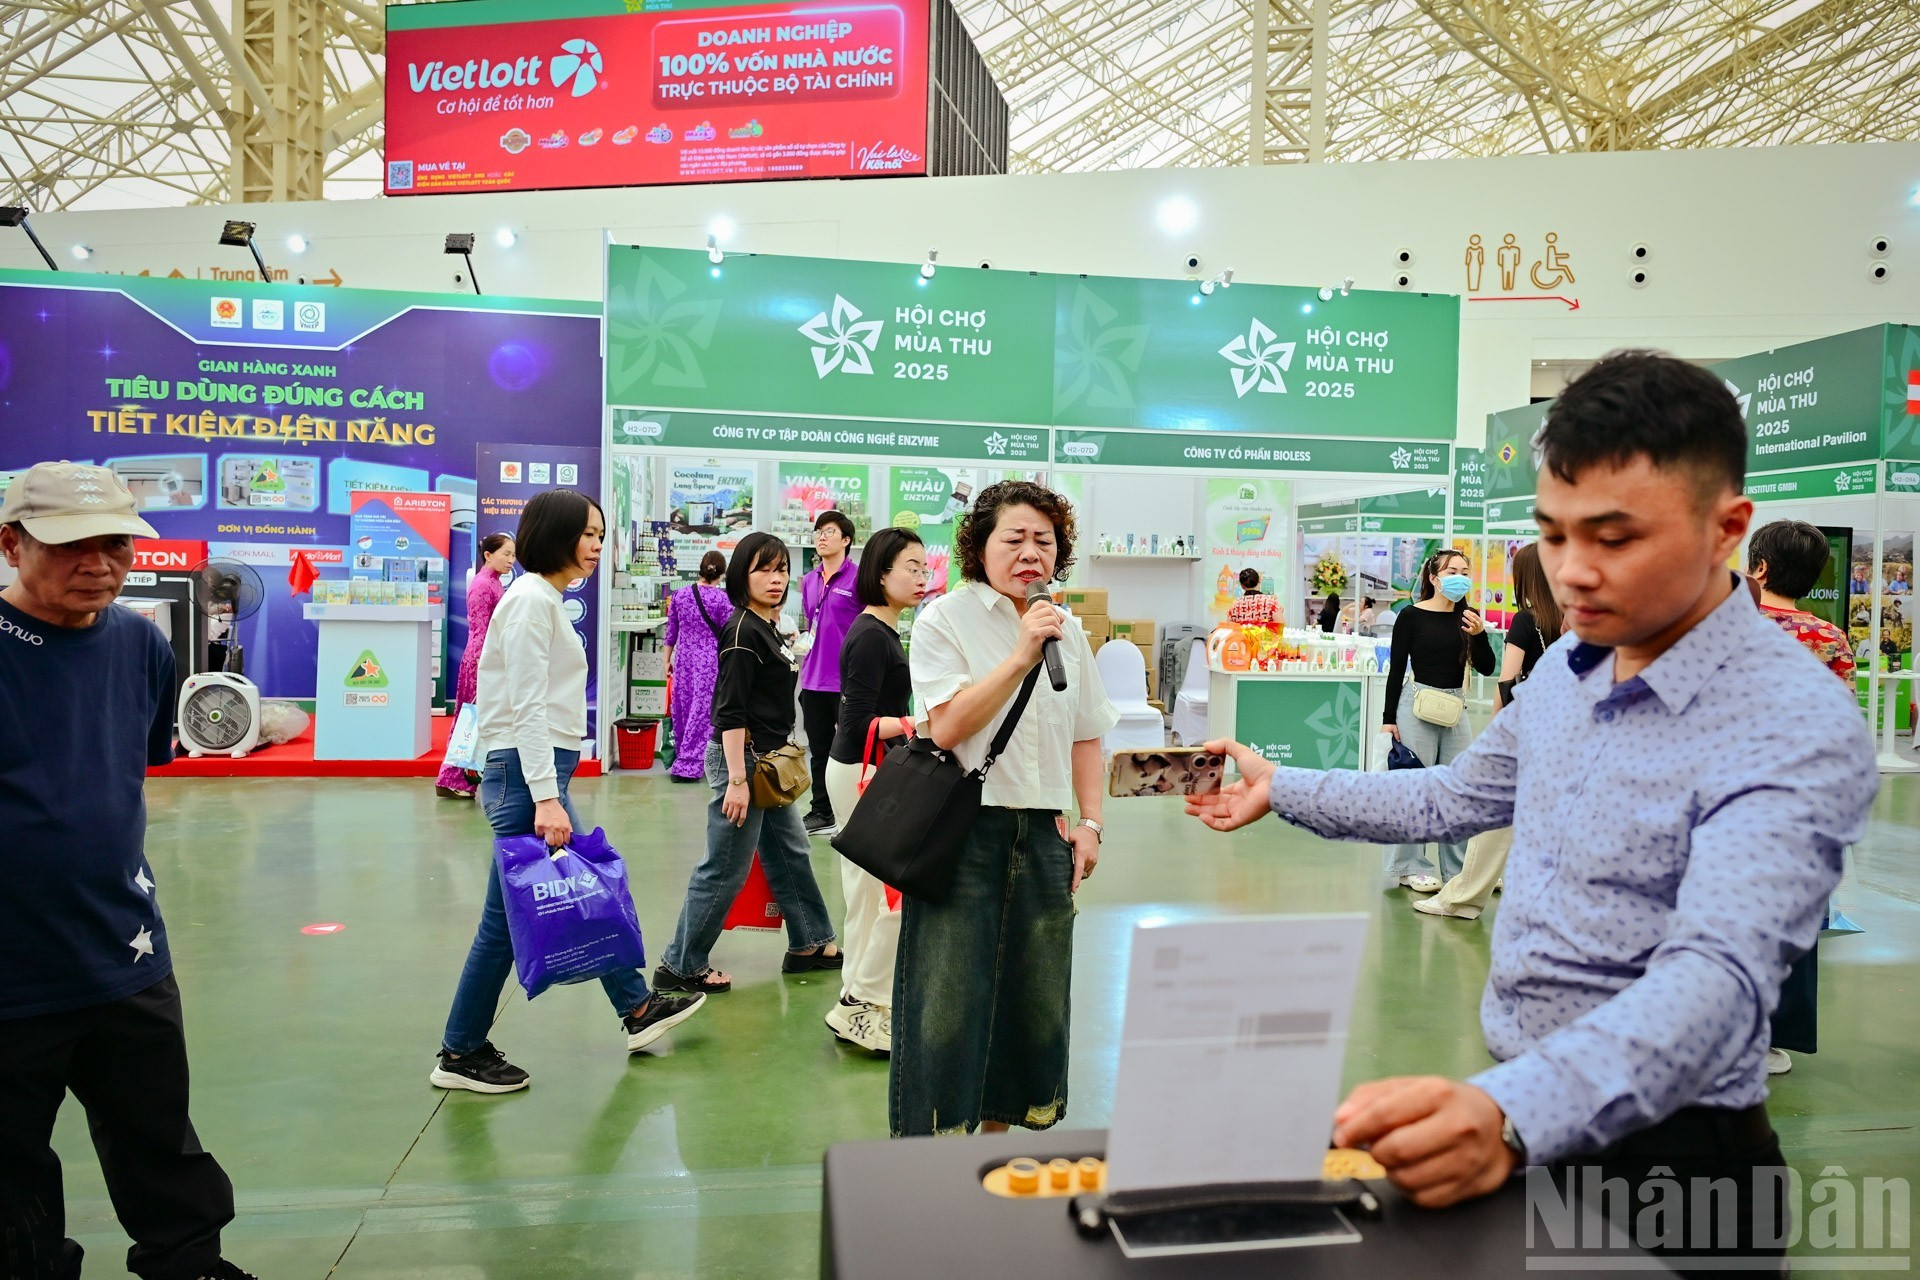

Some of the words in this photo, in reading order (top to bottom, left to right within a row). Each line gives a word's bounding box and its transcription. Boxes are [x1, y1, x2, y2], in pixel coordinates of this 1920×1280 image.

[698, 27, 771, 48] DOANH
[776, 20, 852, 44] NGHIỆP
[659, 52, 729, 77] 100%
[734, 50, 778, 72] VỐN
[783, 48, 828, 70] NHÀ
[832, 45, 893, 67] NƯỚC
[408, 56, 541, 92] Vietlott
[659, 80, 705, 100] TRỰC
[710, 76, 769, 97] THUỘC
[773, 74, 799, 95] BỘ
[803, 74, 831, 90] TÀI
[835, 70, 893, 88] CHÍNH
[437, 99, 455, 114] Cơ
[458, 98, 479, 115] hội
[483, 95, 499, 112] để
[503, 94, 522, 110] tốt
[526, 95, 554, 109] hơn
[417, 162, 437, 172] MUA
[439, 161, 450, 171] VÉ
[452, 161, 466, 172] TẠI
[210, 267, 255, 285] Trung
[896, 304, 932, 336] HỘI
[938, 309, 985, 333] CHỢ
[894, 332, 943, 358] MÙA
[948, 337, 991, 357] THU
[1306, 325, 1341, 355] HỘI
[1346, 330, 1388, 353] CHỢ
[199, 360, 238, 374] GIAN
[243, 360, 288, 377] HÀNG
[292, 364, 337, 379] XANH
[1306, 352, 1350, 372] MÙA
[1355, 357, 1394, 374] THU
[893, 361, 948, 382] 2025
[1758, 373, 1780, 395] HỘI
[1784, 367, 1814, 388] CHỢ
[106, 375, 170, 401] TIÊU
[177, 377, 256, 404] DÙNG
[262, 382, 343, 408] ĐÚNG
[350, 386, 424, 412] CÁCH
[1305, 381, 1355, 399] 2025
[1757, 395, 1786, 415] MÙA
[1790, 391, 1818, 409] THU
[87, 403, 158, 434] TIẾT
[166, 410, 245, 443] KIỆM
[343, 415, 436, 448] NĂNG
[627, 424, 658, 434] H2-07C
[1756, 420, 1789, 437] 2025
[713, 426, 743, 439] CÔNG
[746, 428, 758, 439] TY
[762, 429, 777, 440] CP
[779, 428, 799, 443] TẬP
[801, 430, 832, 443] ĐOÀN
[834, 430, 864, 444] CÔNG
[867, 431, 895, 447] NGHỆ
[898, 434, 939, 447] ENZYME
[1011, 432, 1022, 443] HỘI
[1023, 434, 1038, 443] CHỢ
[1756, 436, 1820, 455] International
[1823, 431, 1867, 447] Pavilion
[1010, 441, 1024, 450] MÙA
[1026, 442, 1039, 450] THU
[1413, 447, 1425, 457] HỘI
[1426, 448, 1438, 456] CHỢ
[1184, 447, 1211, 459] CÔNG
[1214, 449, 1226, 459] TY
[1227, 445, 1242, 460] CỔ
[1244, 447, 1271, 461] PHẦN
[1273, 450, 1311, 462] BIOLESS
[1413, 455, 1427, 463] MÙA
[1461, 461, 1479, 474] HỘI
[674, 470, 714, 480] Cocolung
[717, 476, 748, 486] ENZYME
[1460, 474, 1482, 485] MÙA
[344, 478, 363, 489] TIẾT
[673, 482, 692, 490] Lung
[693, 482, 716, 491] Spray
[785, 475, 862, 490] VINATTO
[899, 477, 945, 493] NHÀU
[1748, 483, 1777, 495] INSTITUTE
[1778, 482, 1797, 492] GMBH
[814, 491, 861, 501] ENZYME
[903, 493, 941, 502] ENZYME
[1460, 488, 1484, 498] 2025
[404, 499, 446, 508] ARISTON
[481, 497, 495, 506] CÁC
[496, 497, 523, 506] THƯƠNG
[484, 507, 499, 516] HIỆU
[500, 507, 517, 516] SUẤT
[217, 524, 240, 535] ĐƠN
[243, 525, 253, 536] VỊ
[255, 523, 285, 535] ĐỒNG
[287, 524, 317, 535] HÀNH
[253, 550, 276, 559] MALL
[134, 574, 152, 584] TIẾP
[1266, 742, 1277, 752] HỘI
[1278, 743, 1291, 752] CHỢ
[1266, 751, 1279, 759] MÙA
[532, 876, 576, 902] BIDV
